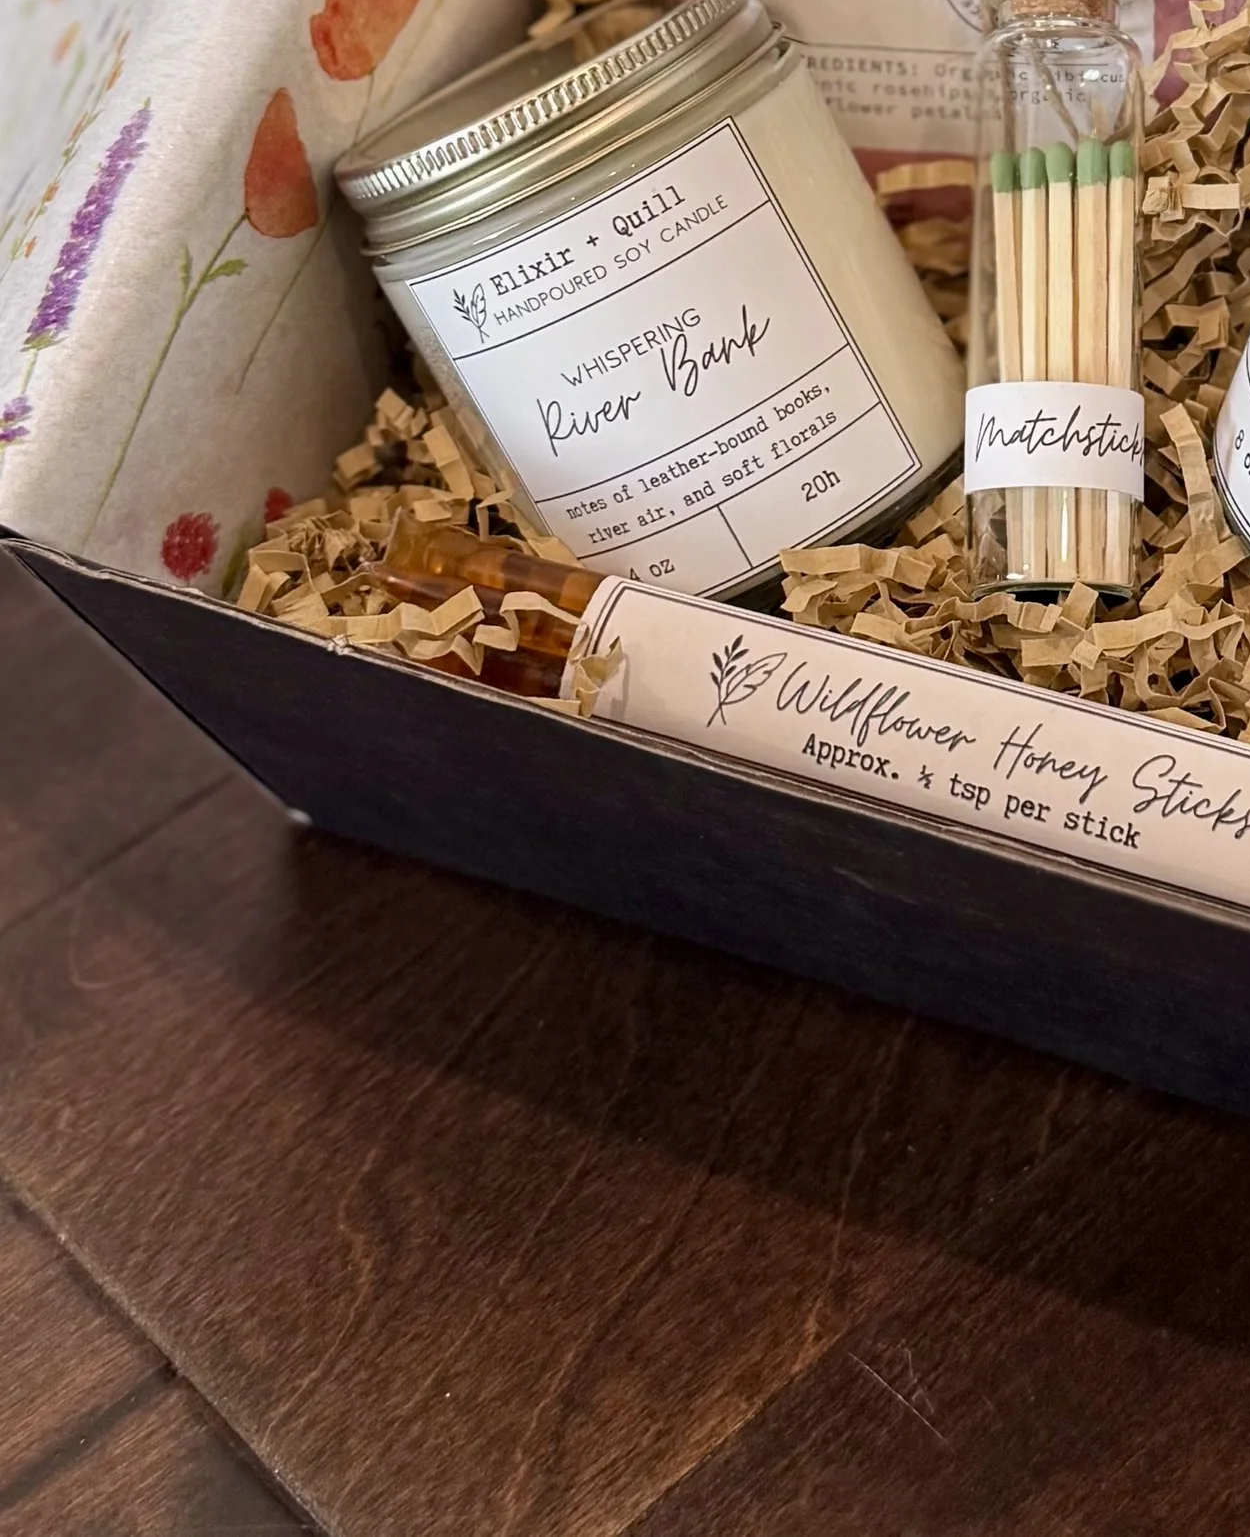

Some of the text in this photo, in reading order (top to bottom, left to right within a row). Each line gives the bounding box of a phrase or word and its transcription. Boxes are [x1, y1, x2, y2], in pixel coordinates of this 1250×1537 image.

[490, 185, 686, 296] Elixir + Quill
[493, 194, 729, 326] HANDPOURED SOY CANDLE
[537, 304, 771, 458] River Bank
[561, 308, 701, 387] WHISPERING
[566, 382, 830, 520] notes of leather-bound books,
[588, 410, 838, 545] river air, and soft florals
[800, 468, 841, 502] 20h
[975, 404, 1144, 467] Matchstick
[1234, 429, 1245, 451] 8
[628, 558, 676, 581] 4 oz
[776, 661, 977, 752] Wildflower
[993, 723, 1109, 805] Honey
[801, 733, 900, 780] Approx.
[949, 773, 991, 810] tsp
[1004, 793, 1052, 820] per
[1063, 811, 1141, 849] stick
